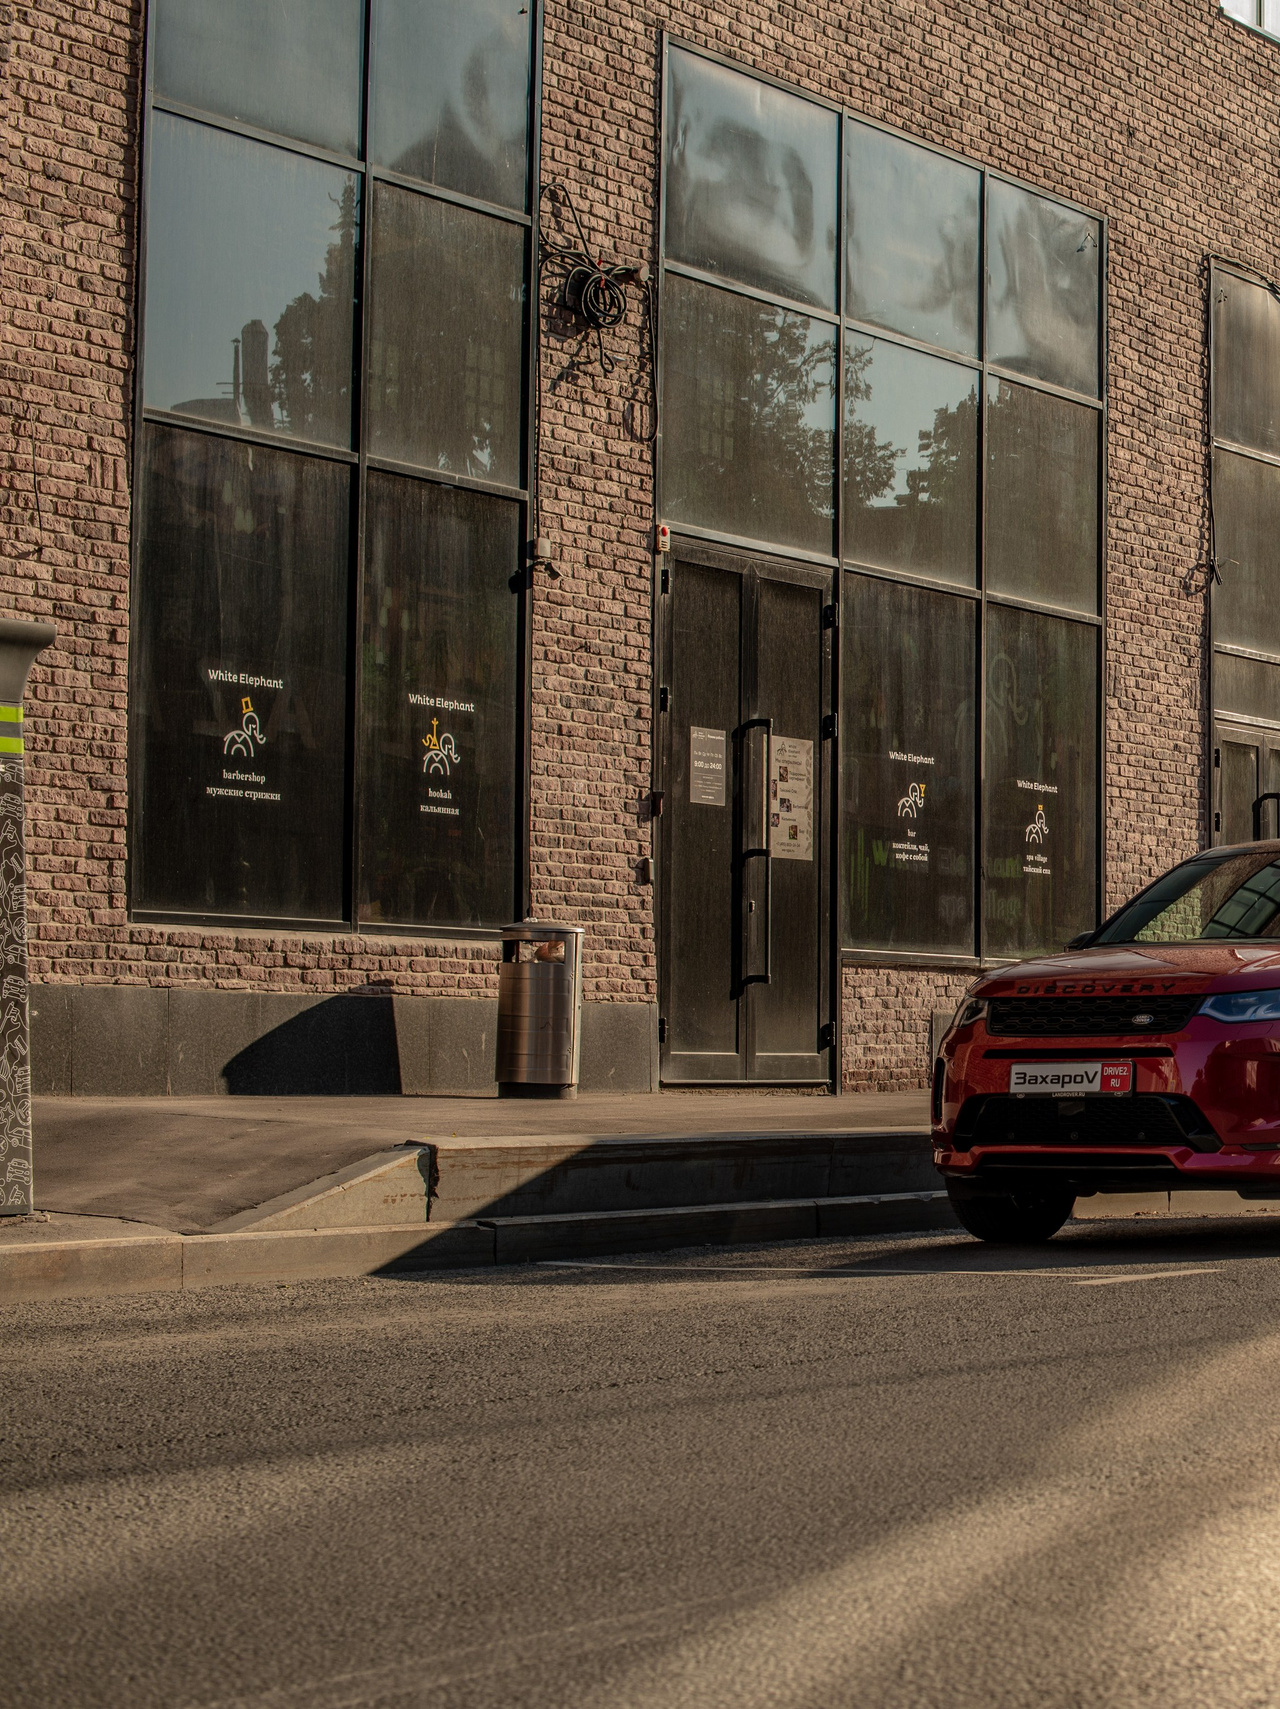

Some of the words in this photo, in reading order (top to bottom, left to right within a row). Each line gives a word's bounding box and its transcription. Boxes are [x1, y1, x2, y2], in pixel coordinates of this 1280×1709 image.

[208, 669, 238, 683] White
[239, 673, 283, 689] Elephant
[408, 693, 435, 706] White
[436, 697, 474, 712] Elephant
[889, 750, 907, 761] White
[908, 754, 934, 764] Elephant
[223, 770, 266, 784] barbershop
[1017, 780, 1033, 790] White
[1034, 782, 1058, 794] Elephant
[206, 786, 244, 798] мужские
[244, 790, 281, 800] стрижки
[428, 788, 452, 800] hookah
[420, 804, 460, 816] кальянная
[908, 829, 916, 838] bar
[892, 842, 918, 852] коктейли,
[918, 844, 930, 852] чай,
[896, 852, 909, 862] кофе
[913, 853, 928, 862] собой
[1035, 854, 1048, 864] village
[1023, 865, 1042, 874] тайский
[1017, 984, 1176, 994] DISCOVERY
[1104, 1066, 1128, 1076] DRIVE2.
[1110, 1079, 1120, 1087] RU
